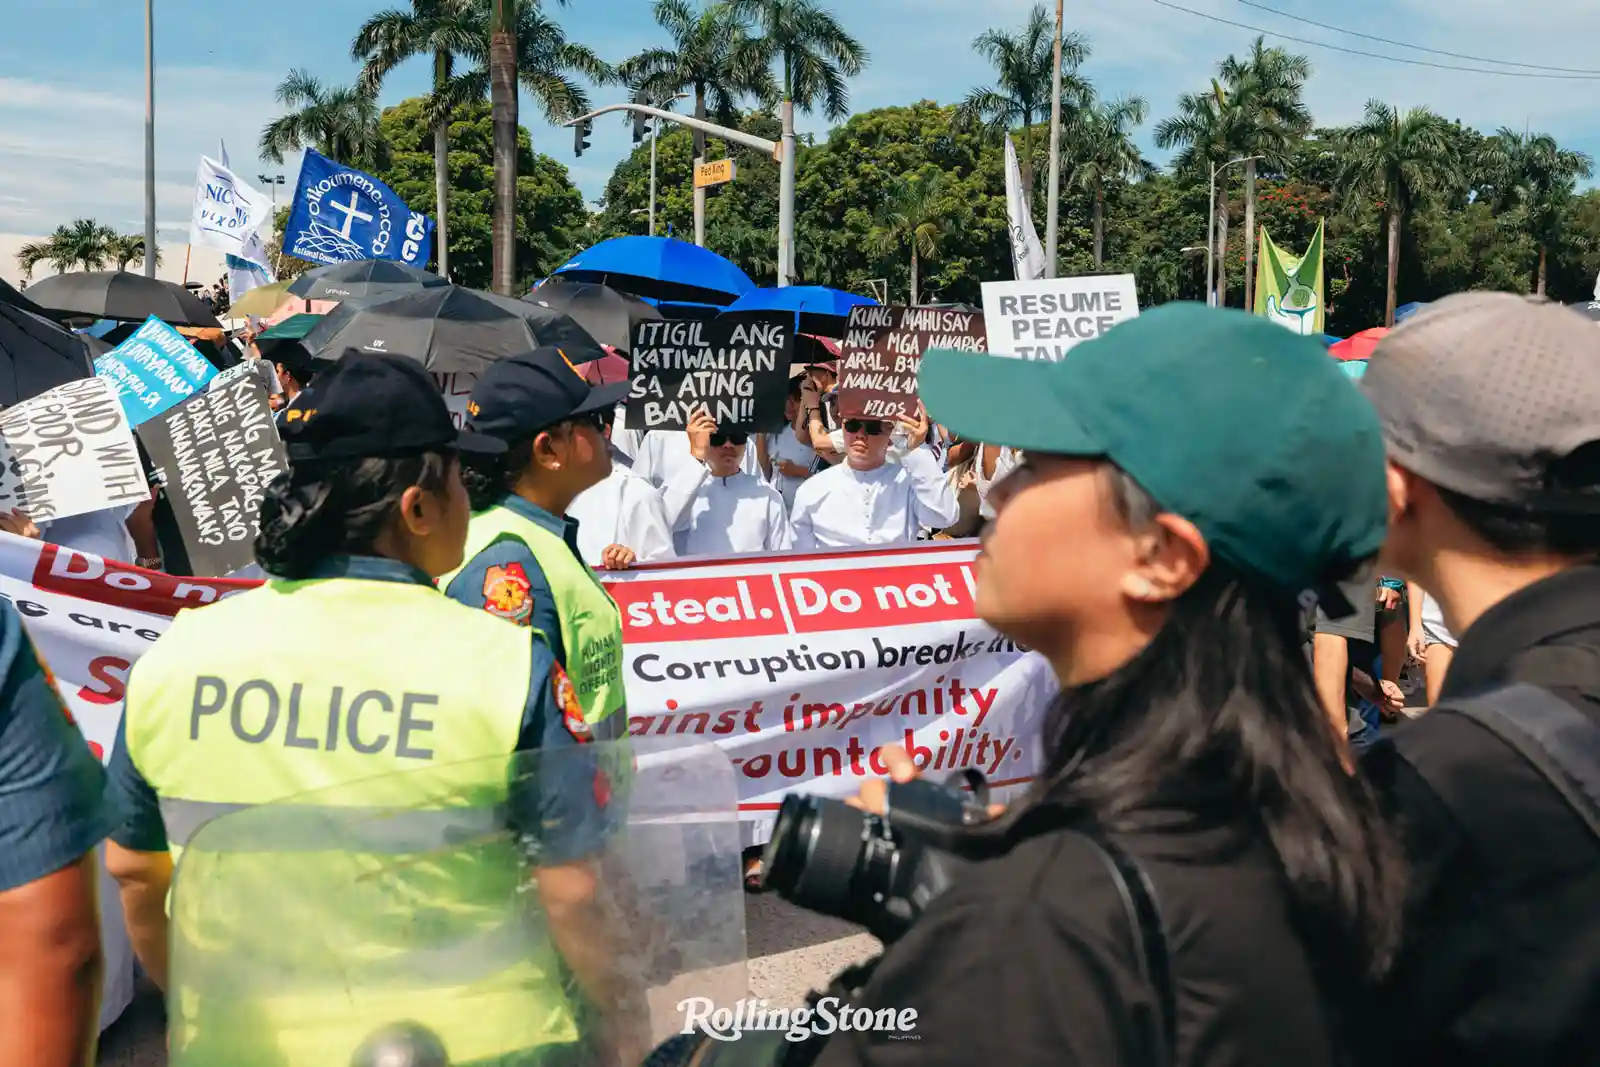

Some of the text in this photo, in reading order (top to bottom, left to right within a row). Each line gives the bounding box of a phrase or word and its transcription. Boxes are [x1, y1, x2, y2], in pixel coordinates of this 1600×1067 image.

[849, 307, 974, 332] KUNG MAHUSAY
[999, 291, 1122, 316] RESUME
[638, 322, 784, 349] ITIGIL ANG
[845, 330, 876, 349] ANG
[887, 332, 919, 355] MGA
[633, 347, 776, 372] KATIWALIAN
[629, 371, 754, 398] SA ATING
[206, 389, 237, 426] ANG
[231, 376, 269, 444] KUNG
[58, 378, 121, 435] STAND
[92, 441, 148, 500] WITH
[166, 412, 225, 545] NINANAKAWAN?
[186, 398, 248, 541] BAKIT NILA TAYO
[49, 545, 151, 591] Do
[628, 579, 773, 628] steal.
[790, 576, 863, 616] Do
[872, 573, 958, 611] not
[68, 611, 162, 642] are
[633, 643, 873, 682] Corruption
[872, 631, 985, 668] breaks
[188, 675, 439, 760] POLICE
[783, 674, 999, 732] impunity
